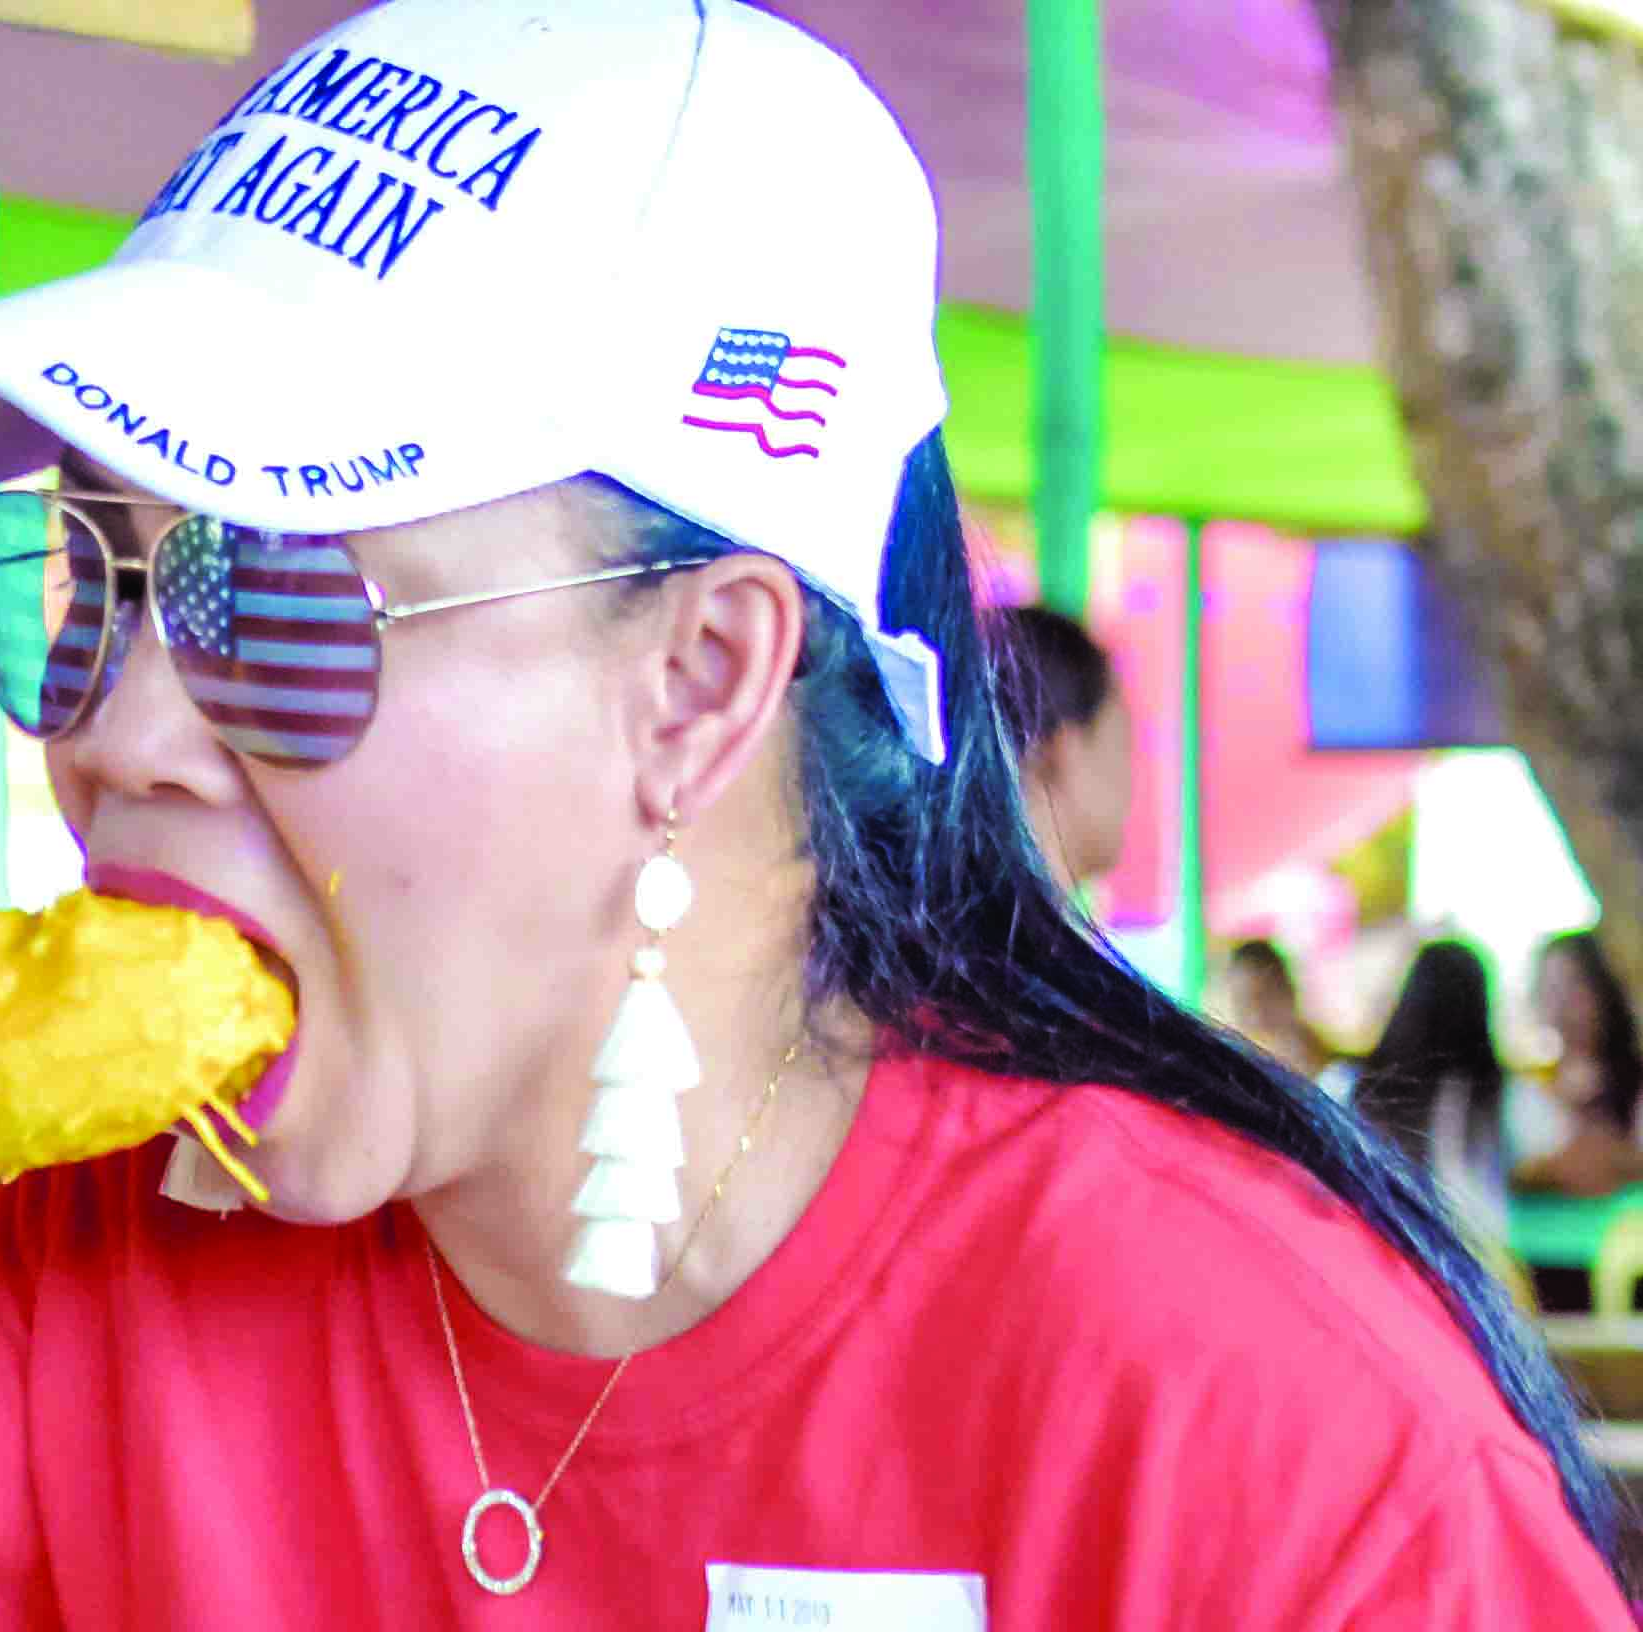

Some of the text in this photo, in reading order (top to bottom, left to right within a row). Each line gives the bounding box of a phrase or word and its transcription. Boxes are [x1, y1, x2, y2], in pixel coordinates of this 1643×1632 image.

[139, 130, 445, 281] AT AGAIN
[244, 49, 543, 213] AMERICA
[41, 361, 429, 500] DONALD TRUMP
